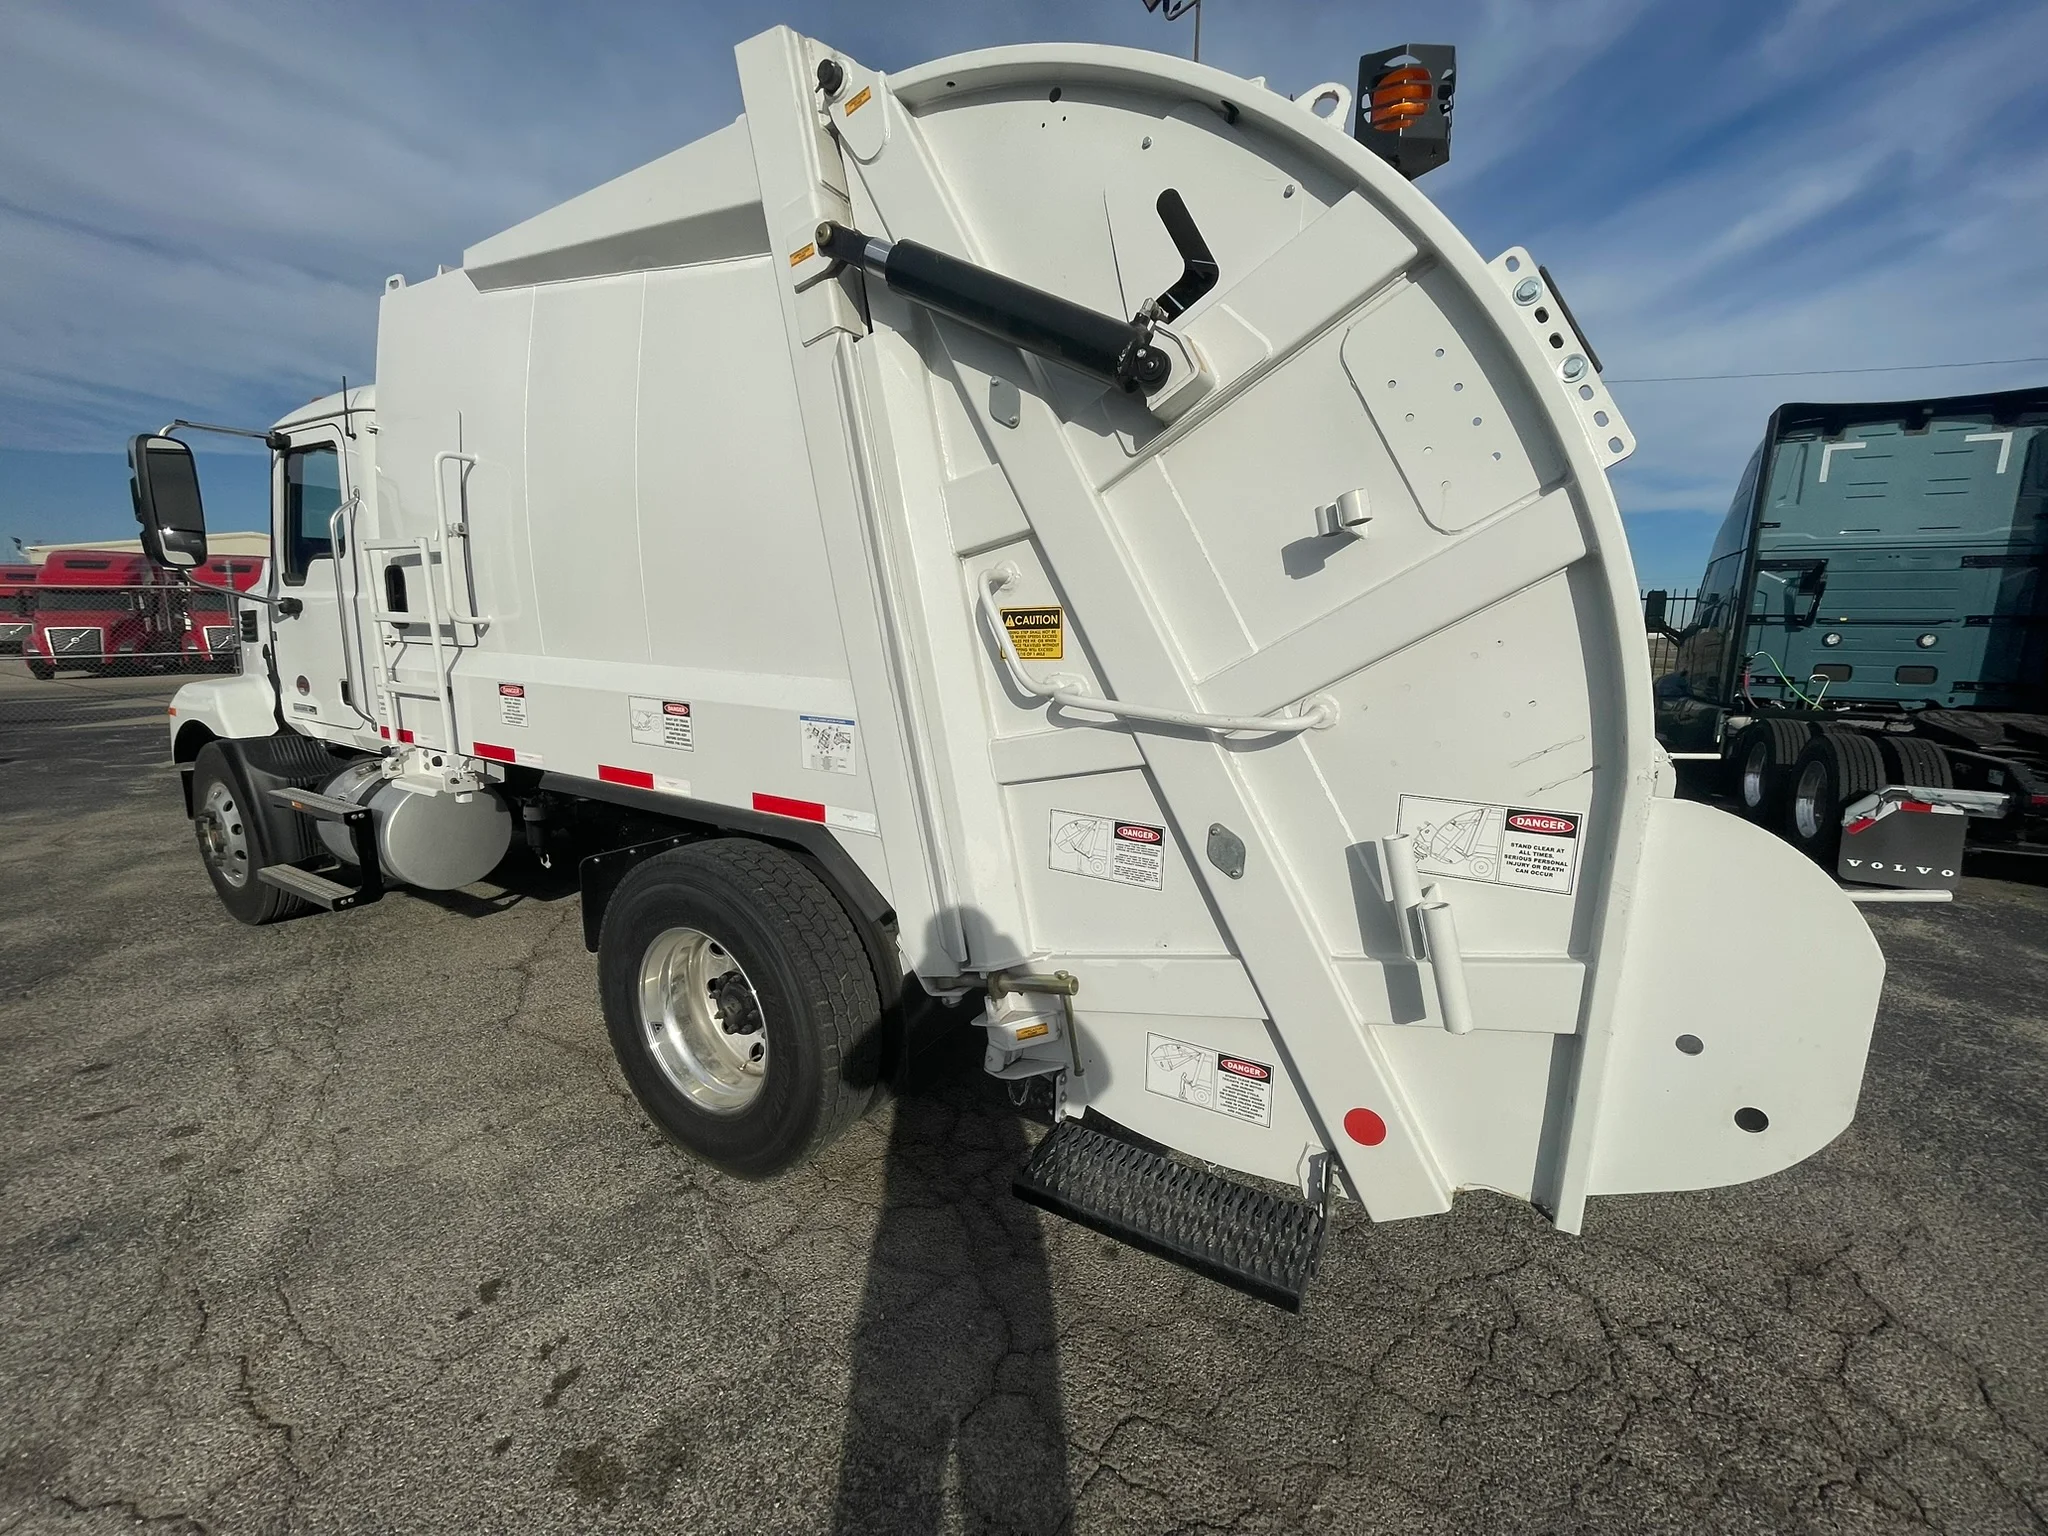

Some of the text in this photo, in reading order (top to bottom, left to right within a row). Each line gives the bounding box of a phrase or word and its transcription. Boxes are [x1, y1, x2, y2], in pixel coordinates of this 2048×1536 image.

[1015, 615, 1058, 625] CAUTION
[1517, 817, 1566, 830] DANGER
[1122, 829, 1153, 840] DANGER
[1504, 854, 1568, 867] SERIOUS PERSONAL
[1847, 858, 1954, 877] VOLVO
[1227, 1062, 1261, 1076] DANGER
